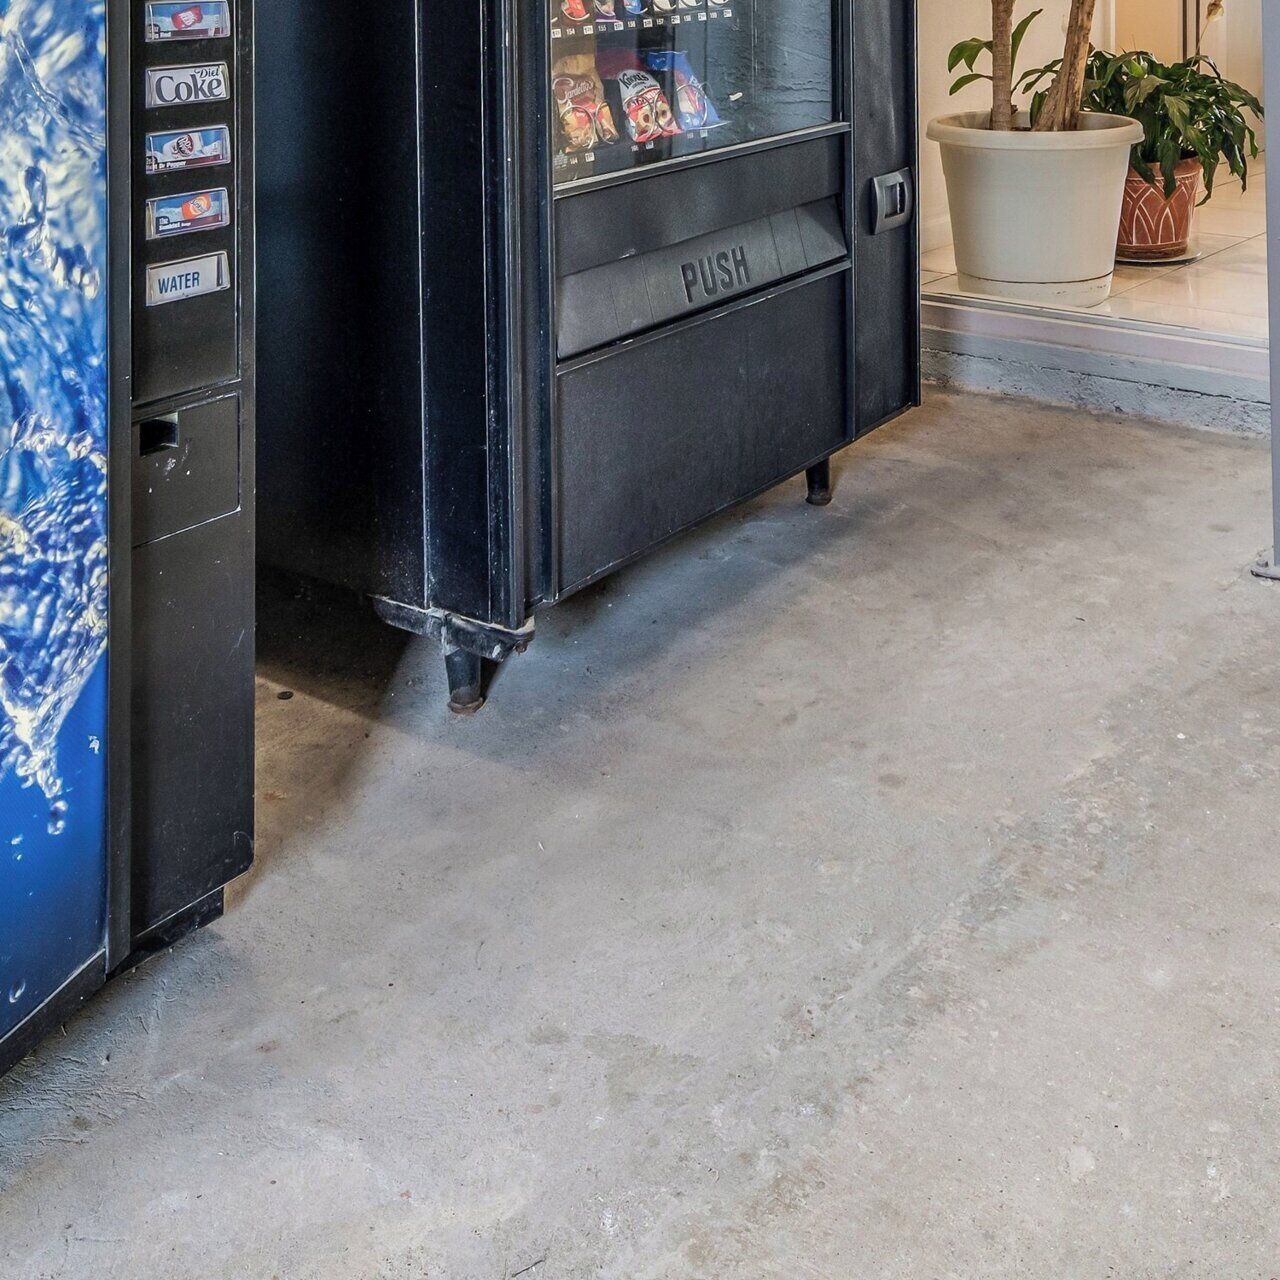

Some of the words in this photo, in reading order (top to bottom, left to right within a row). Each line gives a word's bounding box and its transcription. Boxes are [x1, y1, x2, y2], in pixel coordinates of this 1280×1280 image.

[155, 73, 222, 103] Coke
[158, 271, 201, 295] WATER
[680, 245, 751, 304] PUSH
